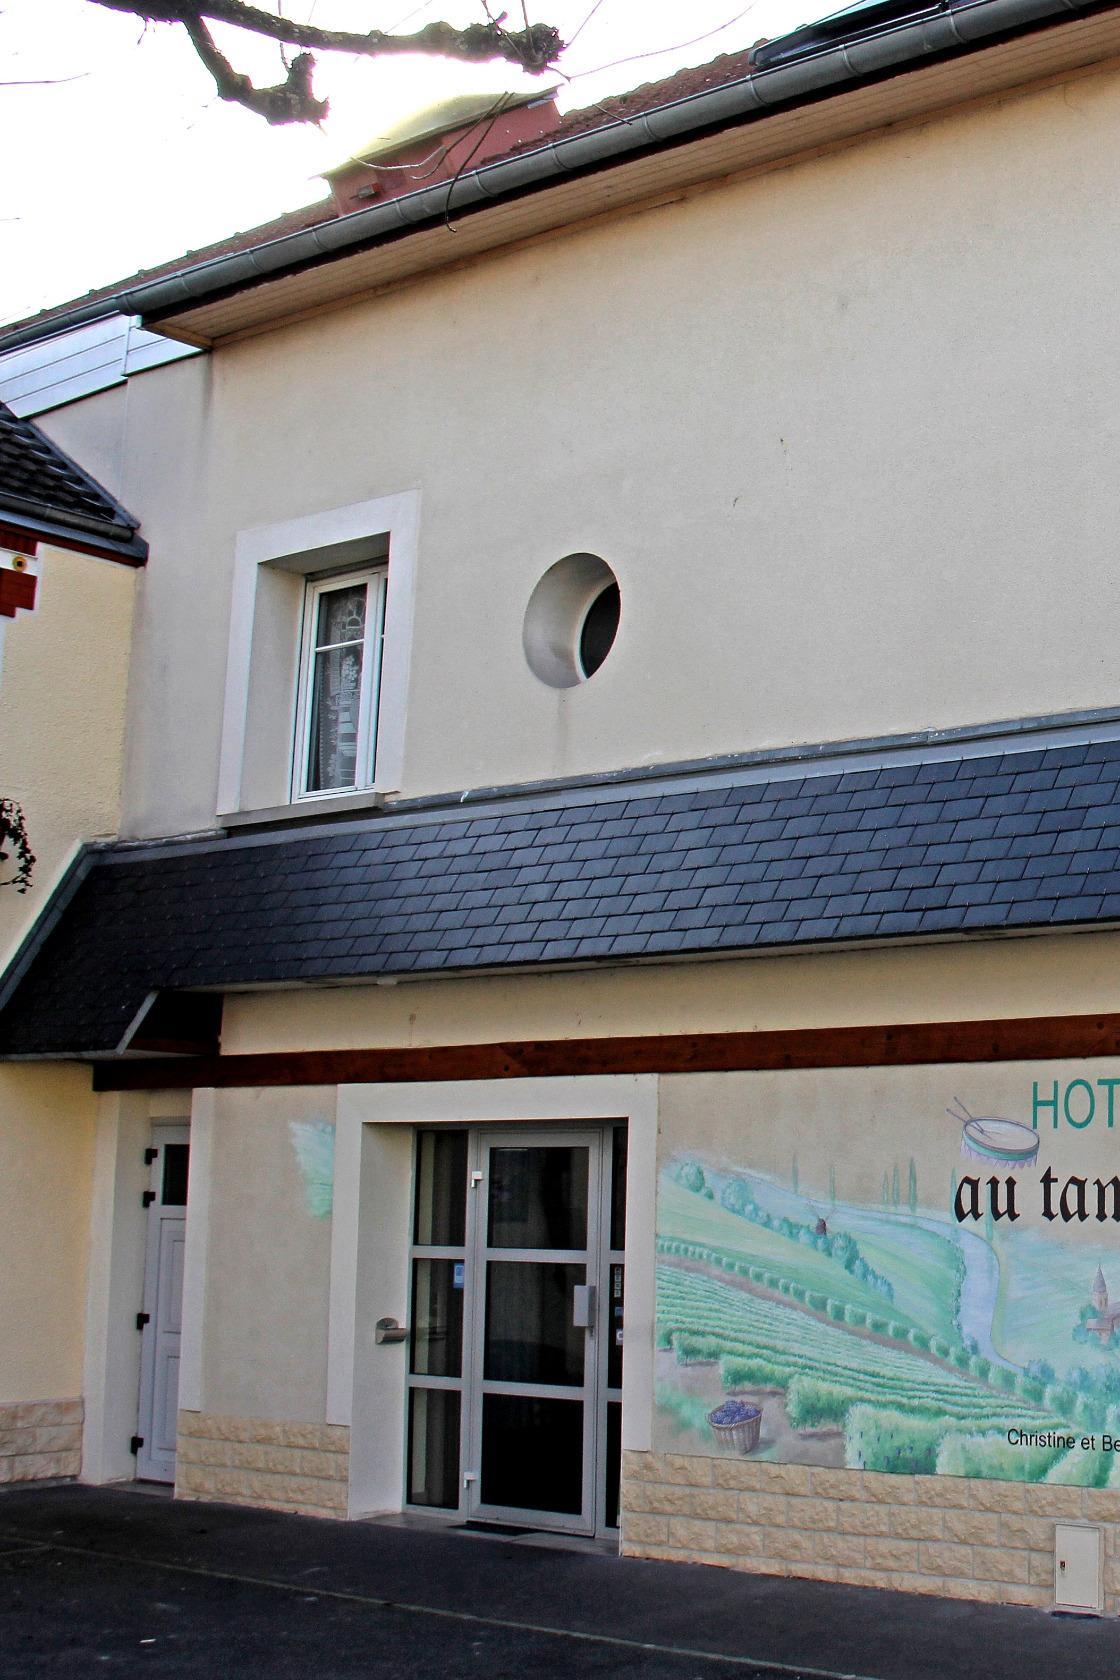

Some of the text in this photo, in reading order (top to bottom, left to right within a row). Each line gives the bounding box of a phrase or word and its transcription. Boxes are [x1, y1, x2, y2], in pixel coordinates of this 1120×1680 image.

[954, 1174, 1021, 1223] au
[1007, 1428, 1076, 1450] Christine
[1081, 1436, 1096, 1451] et
